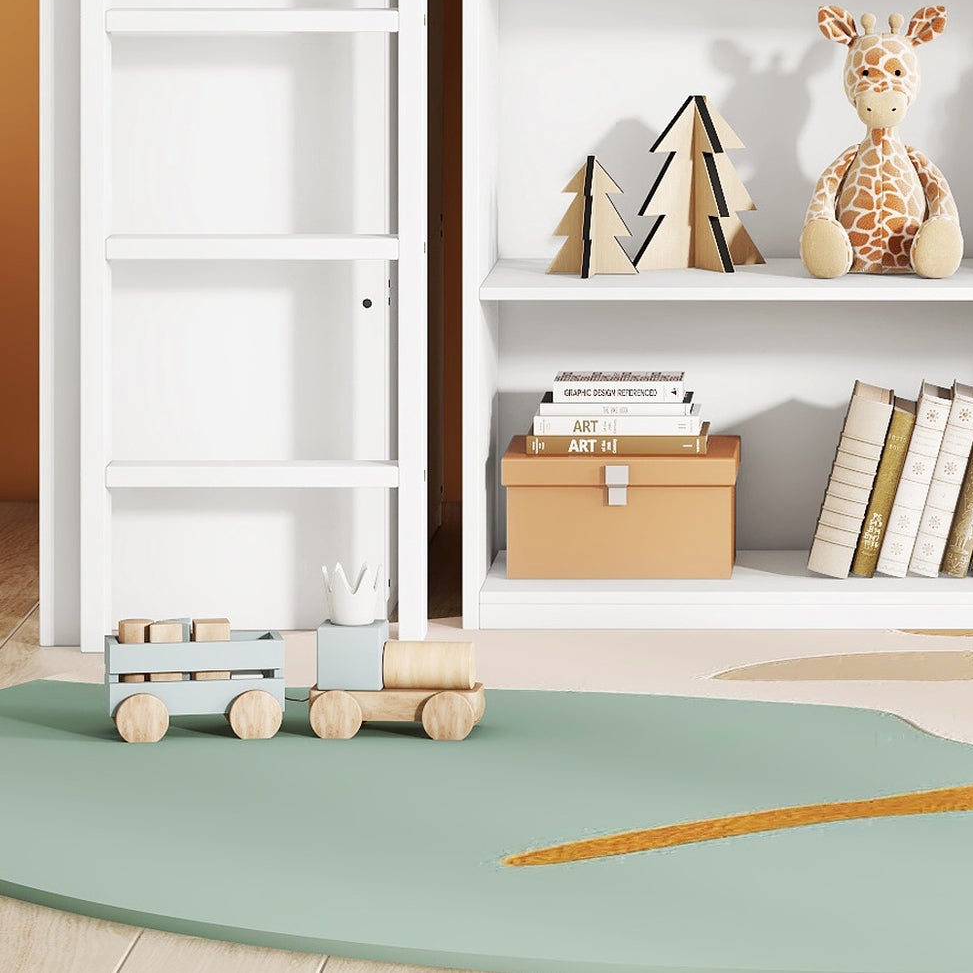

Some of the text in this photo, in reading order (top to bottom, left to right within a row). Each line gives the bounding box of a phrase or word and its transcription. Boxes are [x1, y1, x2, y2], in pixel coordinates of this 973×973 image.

[563, 388, 658, 397] GRAPHIC DESIGN REFERENCED
[573, 419, 599, 433] ART
[567, 438, 598, 453] ART
